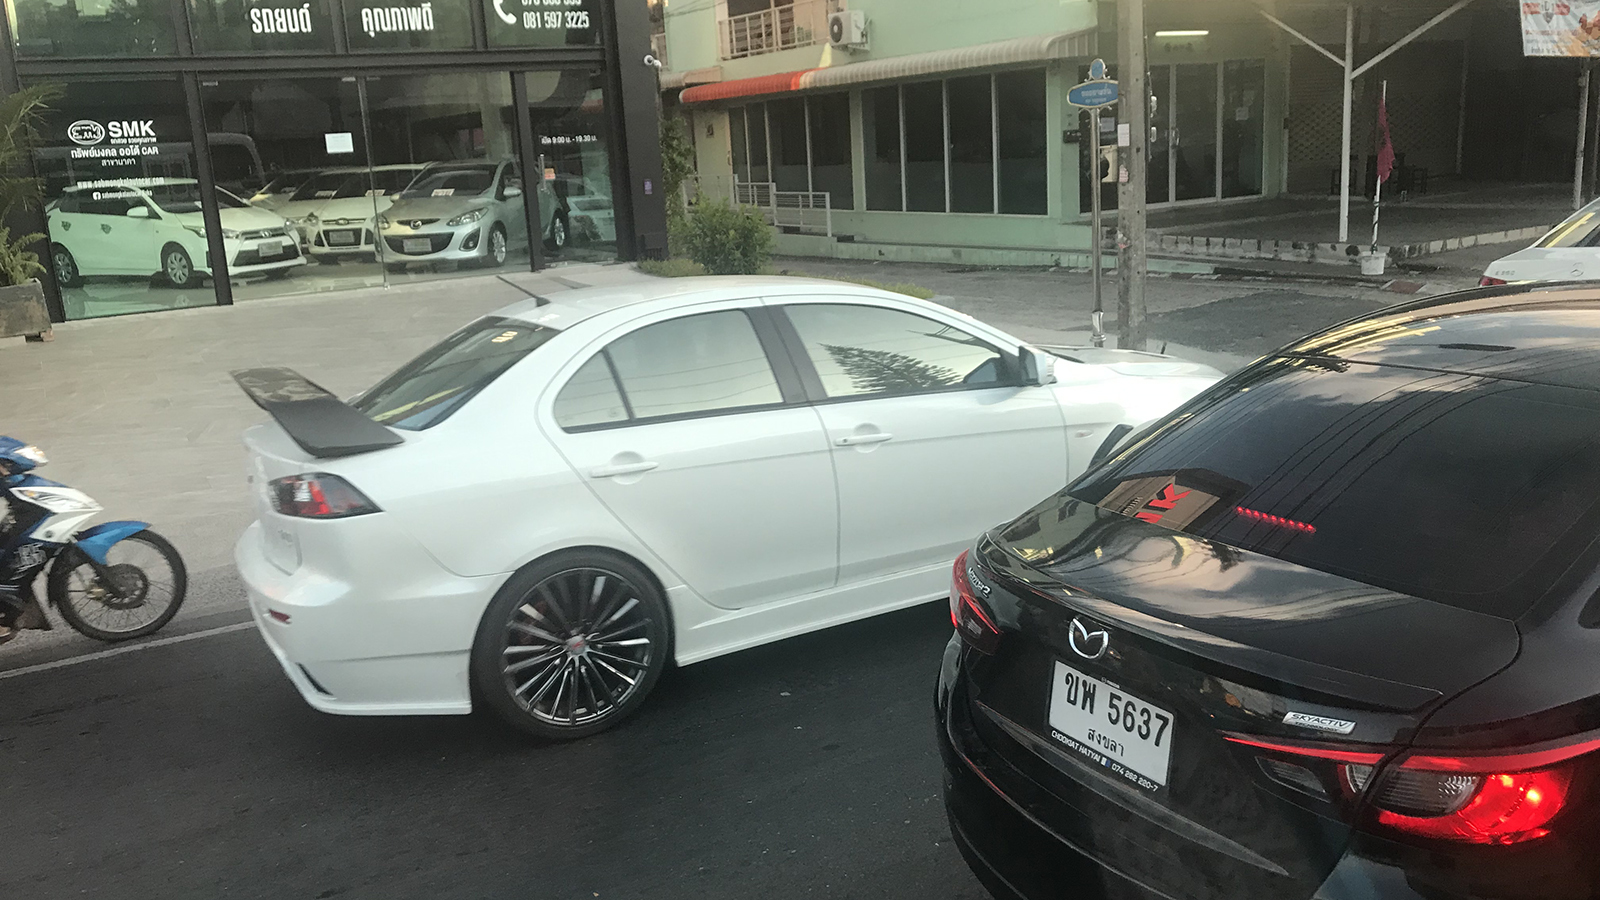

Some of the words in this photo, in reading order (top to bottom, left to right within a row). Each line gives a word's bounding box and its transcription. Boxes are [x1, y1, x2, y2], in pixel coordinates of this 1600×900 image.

[250, 3, 312, 33] รถยนต์
[361, 2, 434, 38] คุณภาพดี
[523, 11, 541, 29] 081
[544, 11, 562, 28] 597
[564, 11, 590, 28] 3225
[107, 120, 156, 138] SMK
[141, 146, 159, 156] CAR
[1065, 672, 1097, 714] ขพ
[1108, 692, 1170, 747] 5637
[1291, 714, 1349, 727] SKYACTIV
[1088, 728, 1125, 757] สงขลา
[1079, 745, 1101, 762] HATYAI
[1111, 763, 1124, 775] 074
